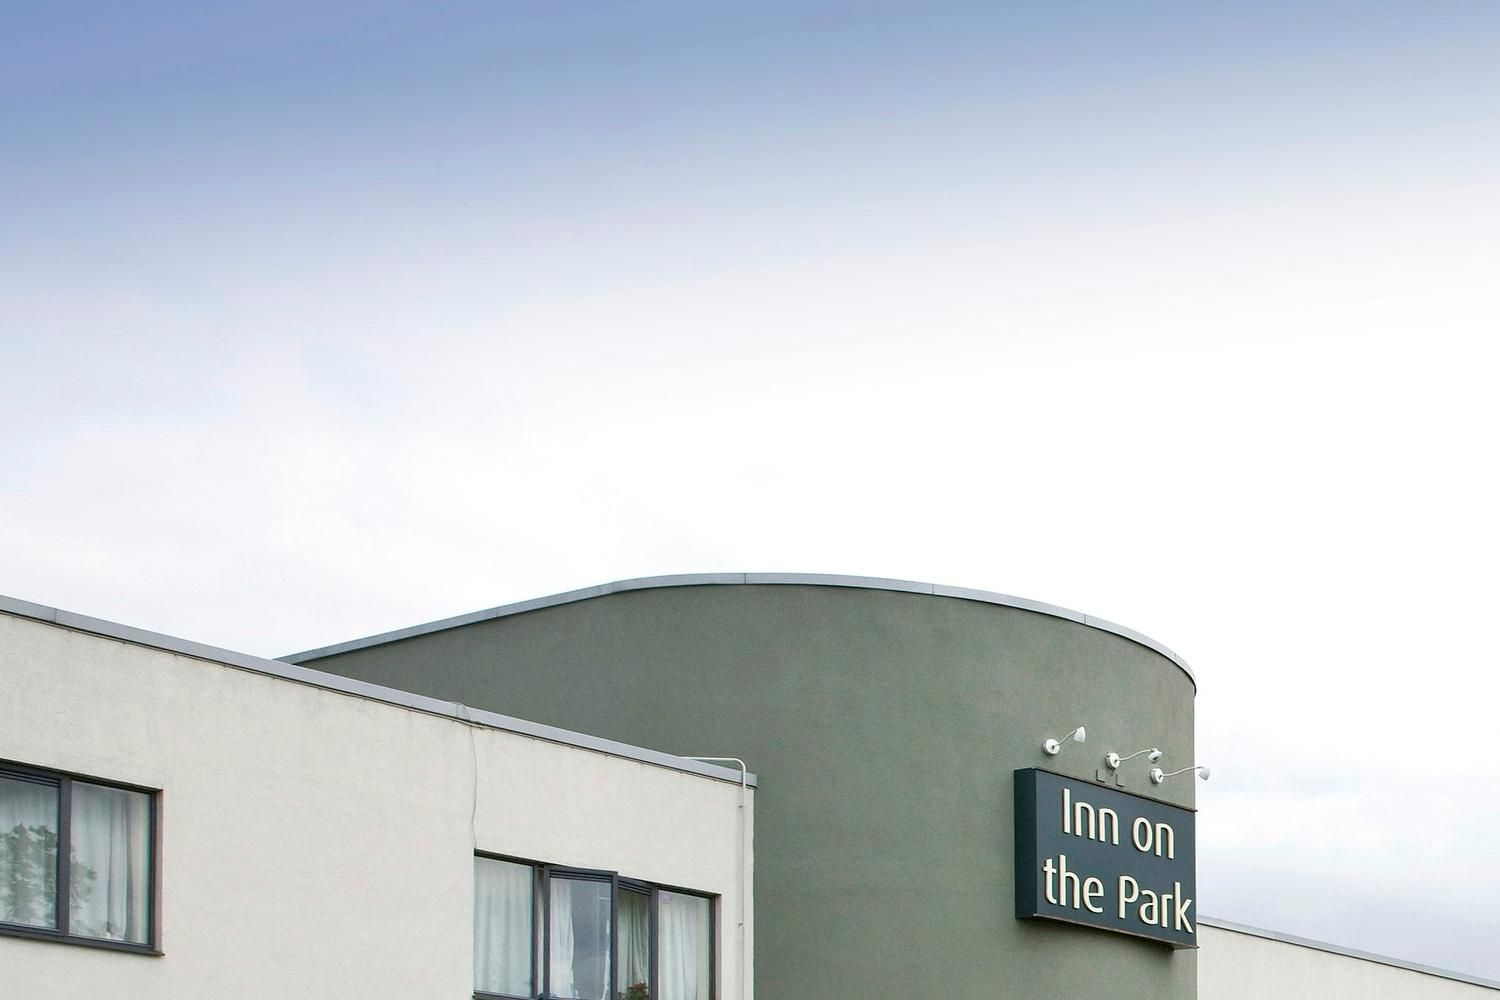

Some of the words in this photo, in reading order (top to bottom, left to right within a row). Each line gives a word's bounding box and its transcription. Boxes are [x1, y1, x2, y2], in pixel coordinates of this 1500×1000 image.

[1062, 788, 1119, 845] Inn
[1132, 817, 1174, 859] on
[1043, 854, 1104, 913] the
[1119, 875, 1193, 933] Park
